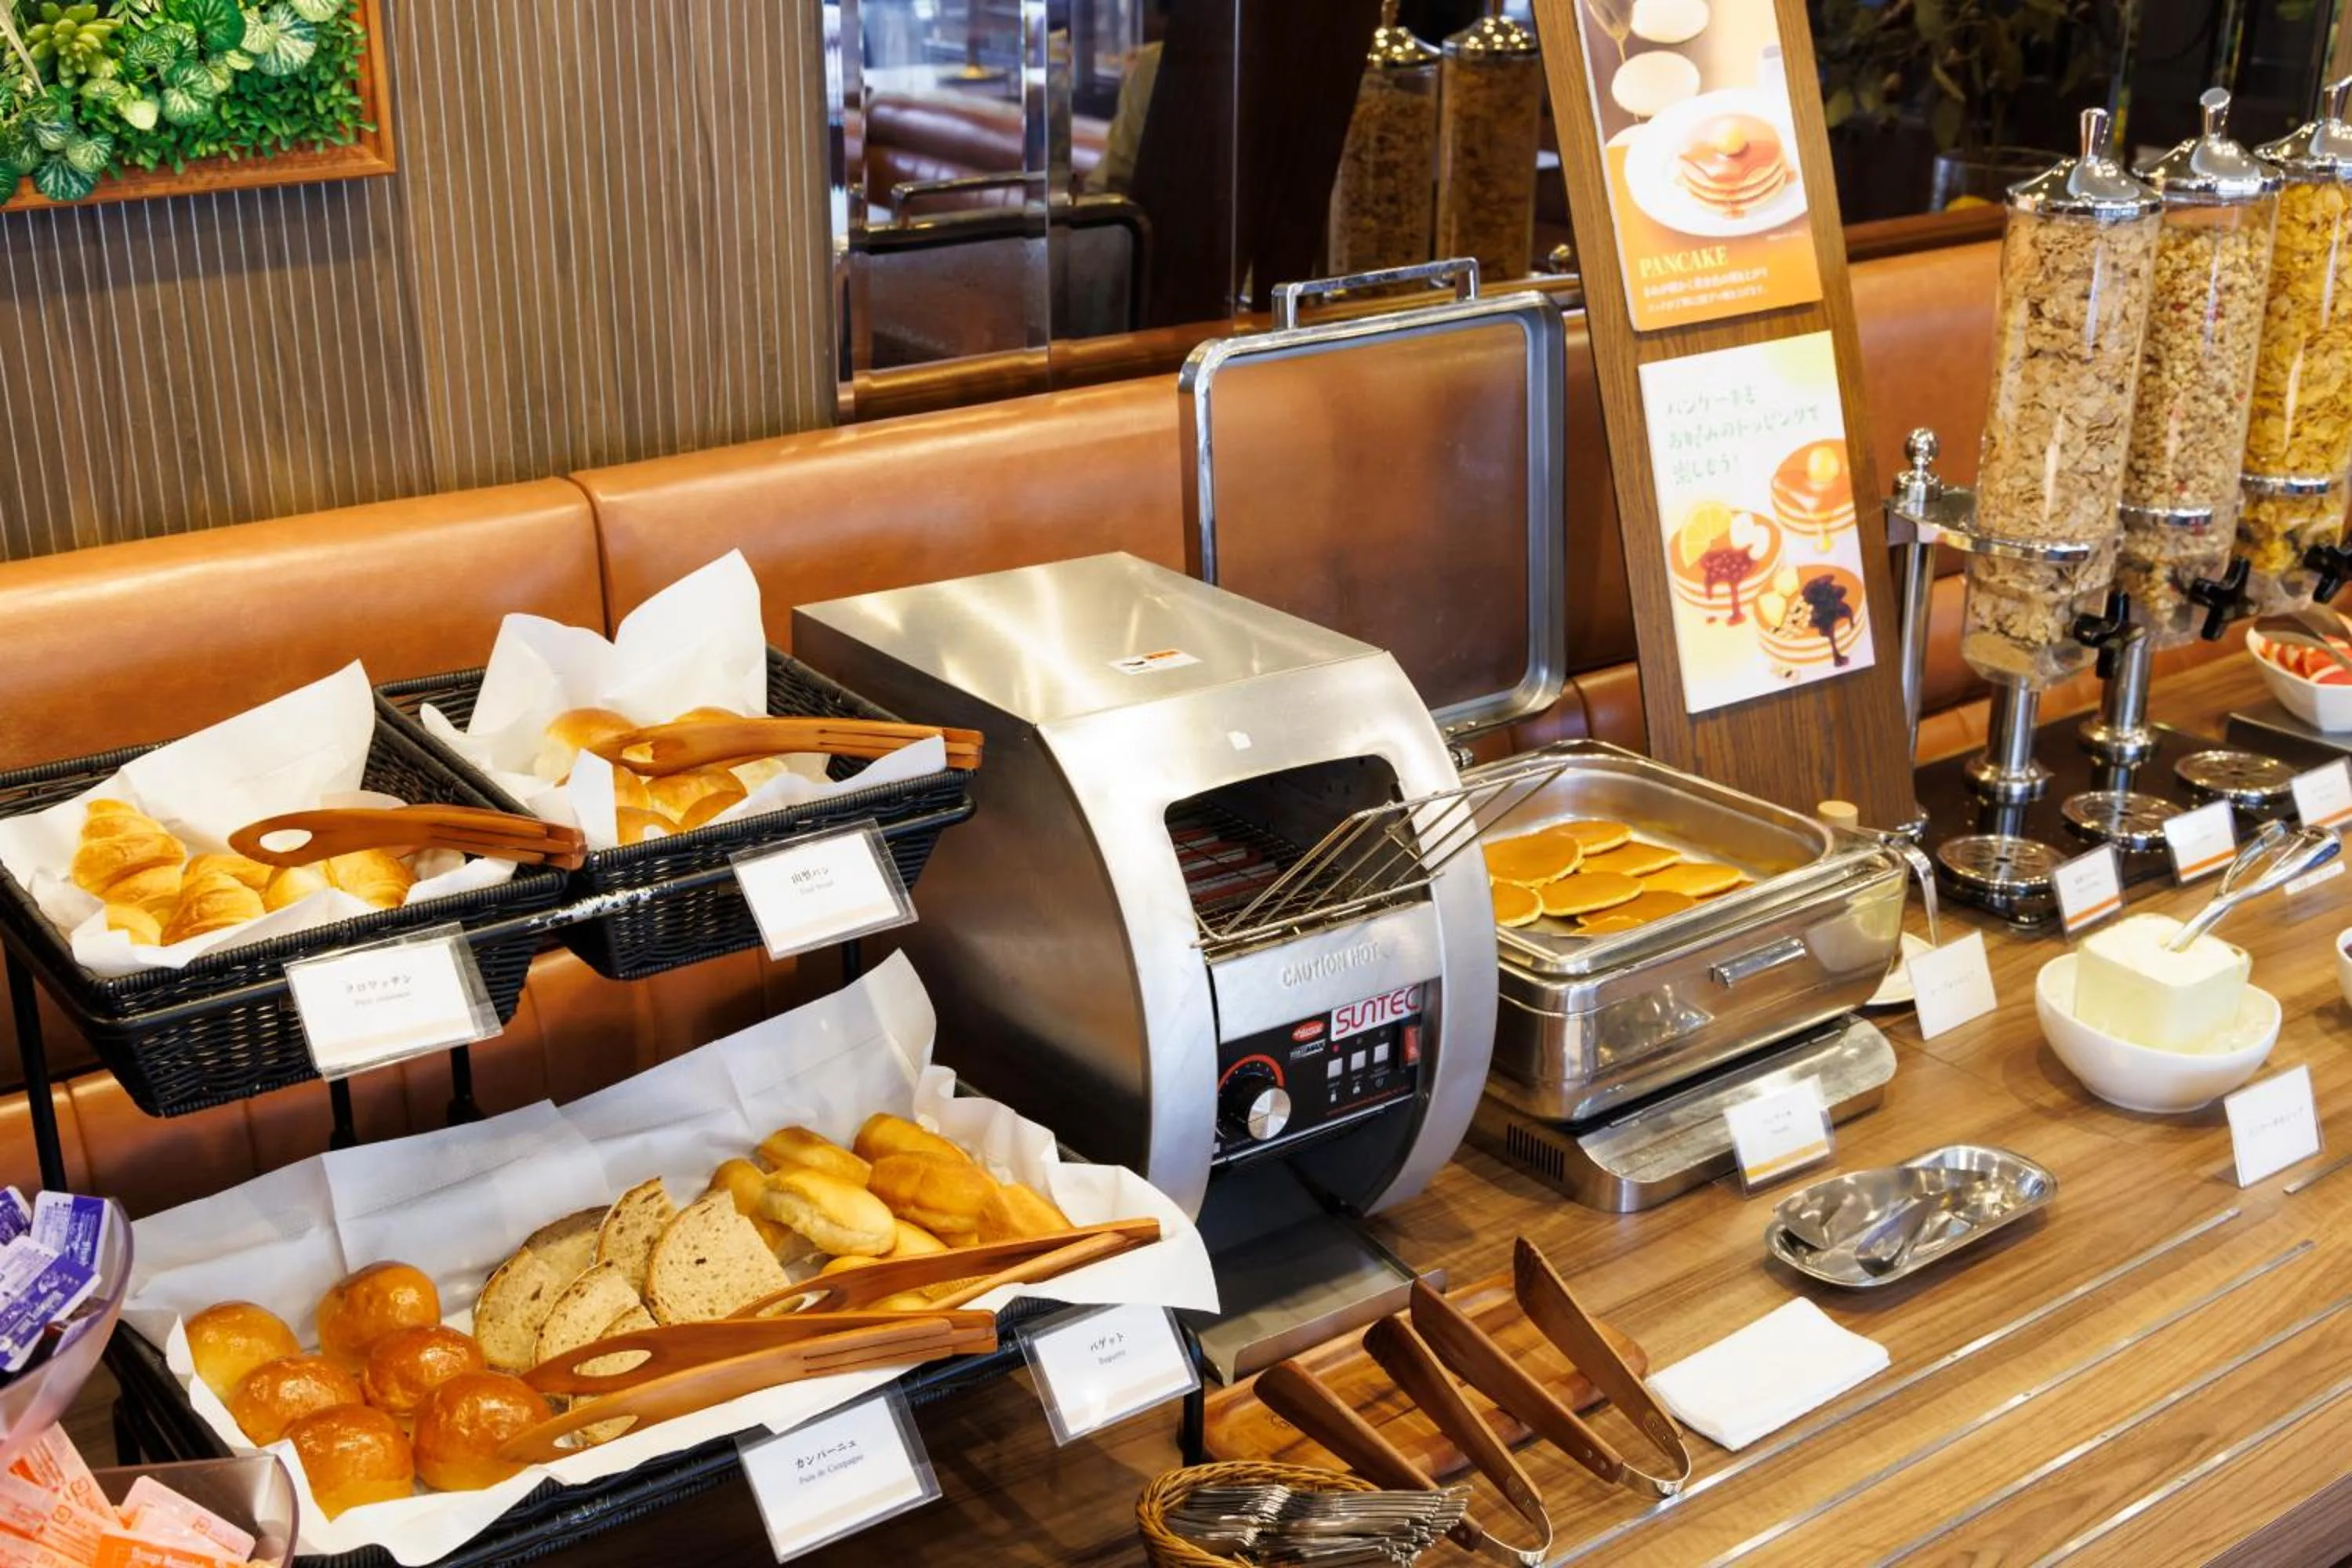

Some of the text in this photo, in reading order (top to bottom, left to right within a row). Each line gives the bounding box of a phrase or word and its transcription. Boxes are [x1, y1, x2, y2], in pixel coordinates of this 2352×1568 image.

[1639, 246, 1728, 279] PANCAKE
[1282, 942, 1380, 989] CAUTION HOT
[1335, 985, 1421, 1036] SUNTEC
